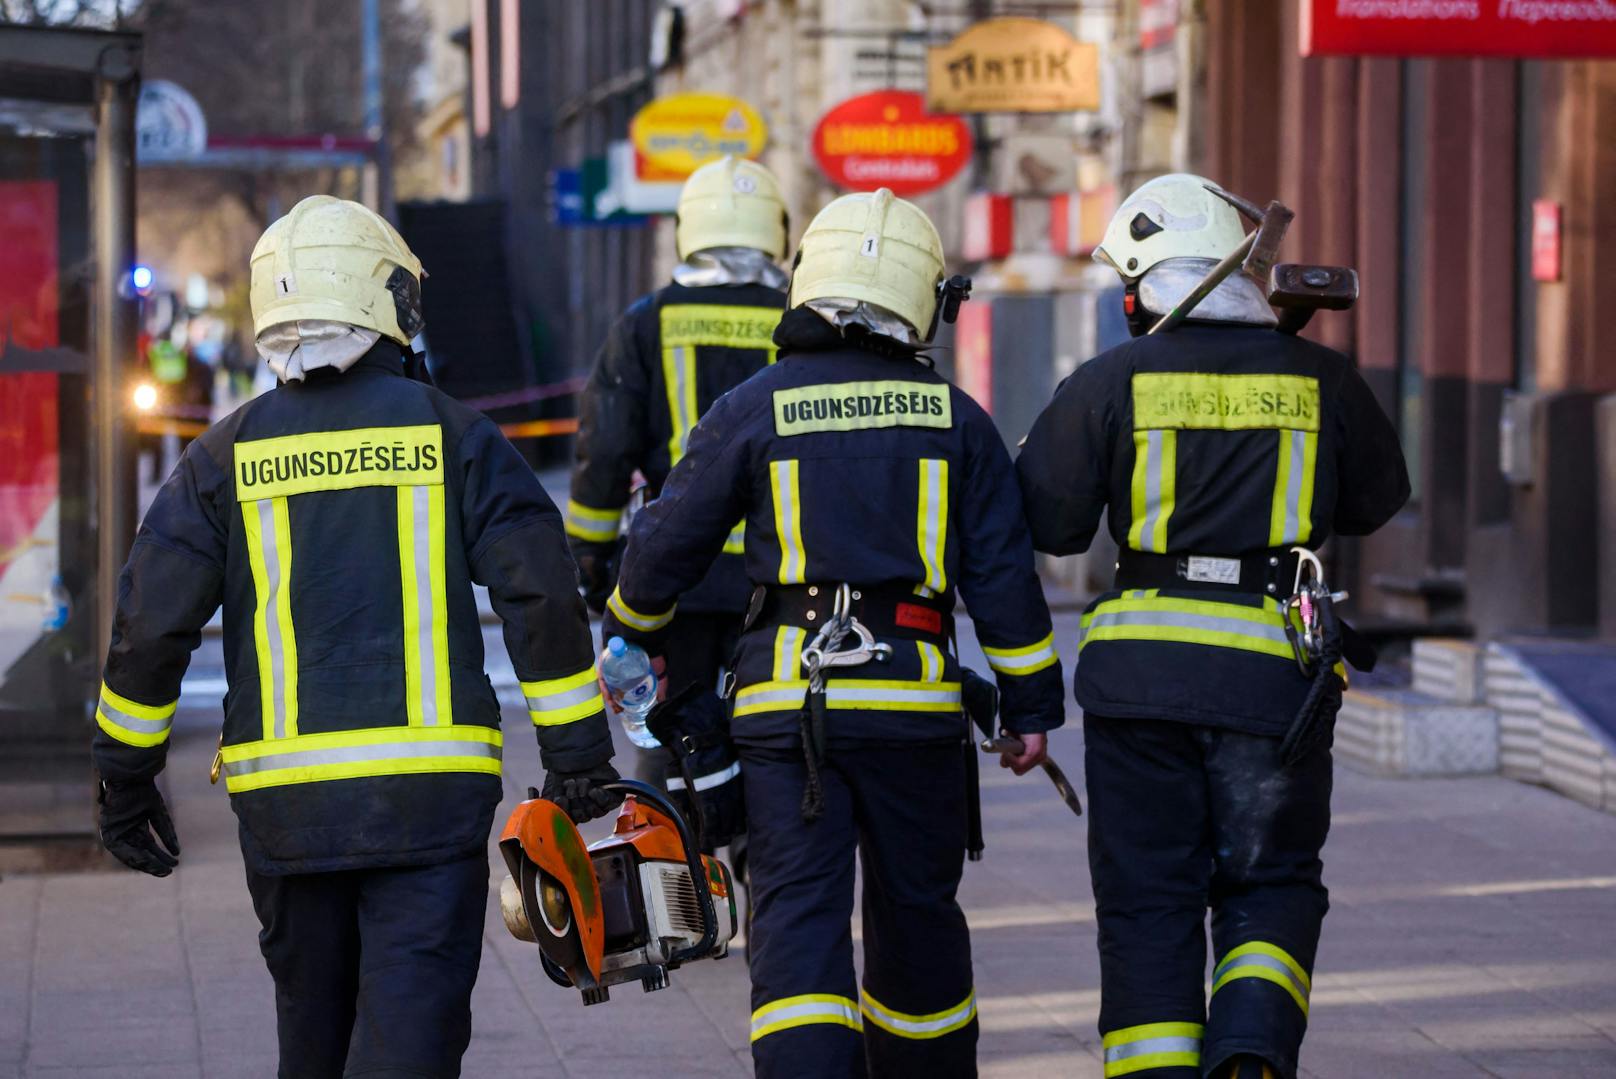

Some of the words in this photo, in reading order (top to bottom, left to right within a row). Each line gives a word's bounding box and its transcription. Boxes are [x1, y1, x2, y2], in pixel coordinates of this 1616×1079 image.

[867, 239, 873, 252] 1
[279, 277, 289, 293] 1
[782, 391, 944, 424] UGUNSDZĒSĒJS
[241, 441, 438, 487] UGUNSDZĒSĒJS
